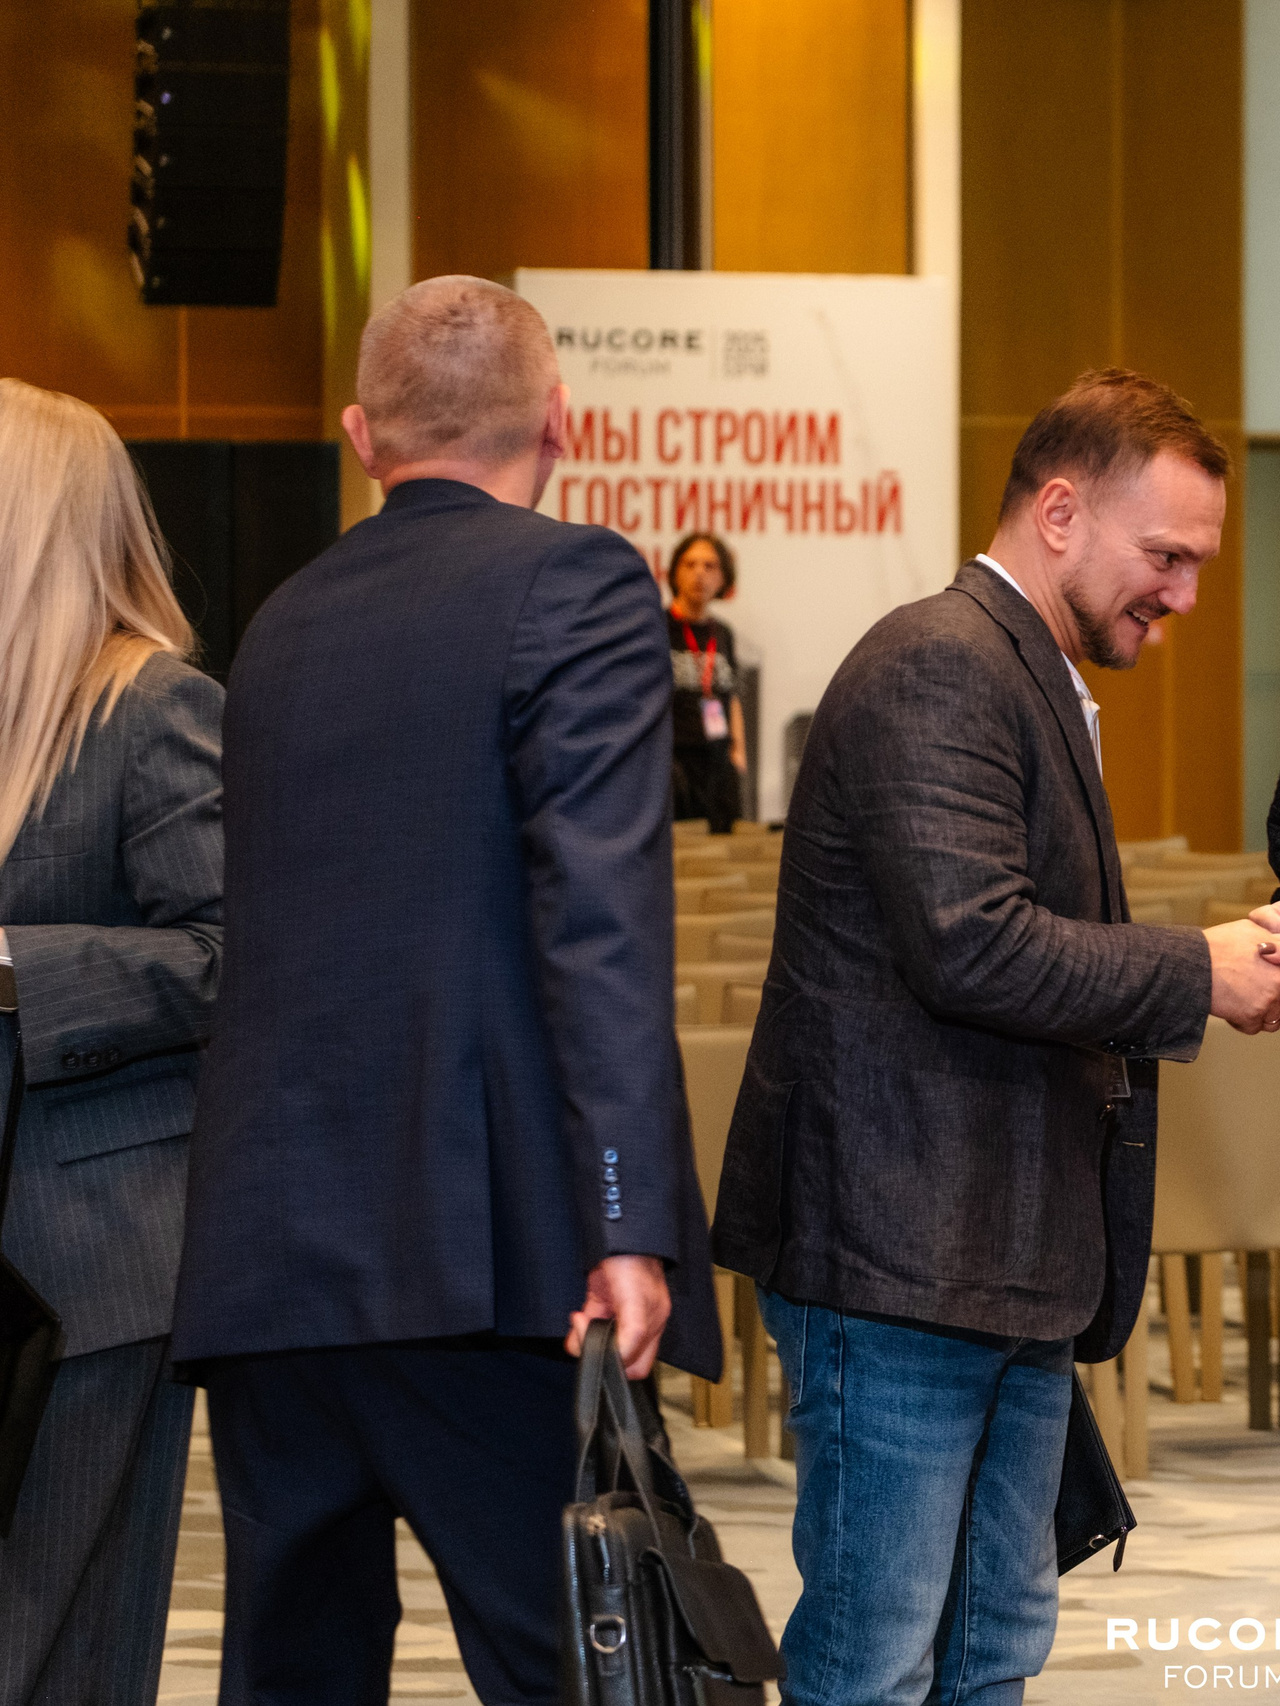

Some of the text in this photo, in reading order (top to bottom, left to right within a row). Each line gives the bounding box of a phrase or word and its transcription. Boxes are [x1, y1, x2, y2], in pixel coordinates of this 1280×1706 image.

[556, 327, 703, 353] RUCORE
[565, 407, 842, 466] МЫ СТРОИМ
[559, 468, 904, 536] ГОСТИНИЧНЫЙ
